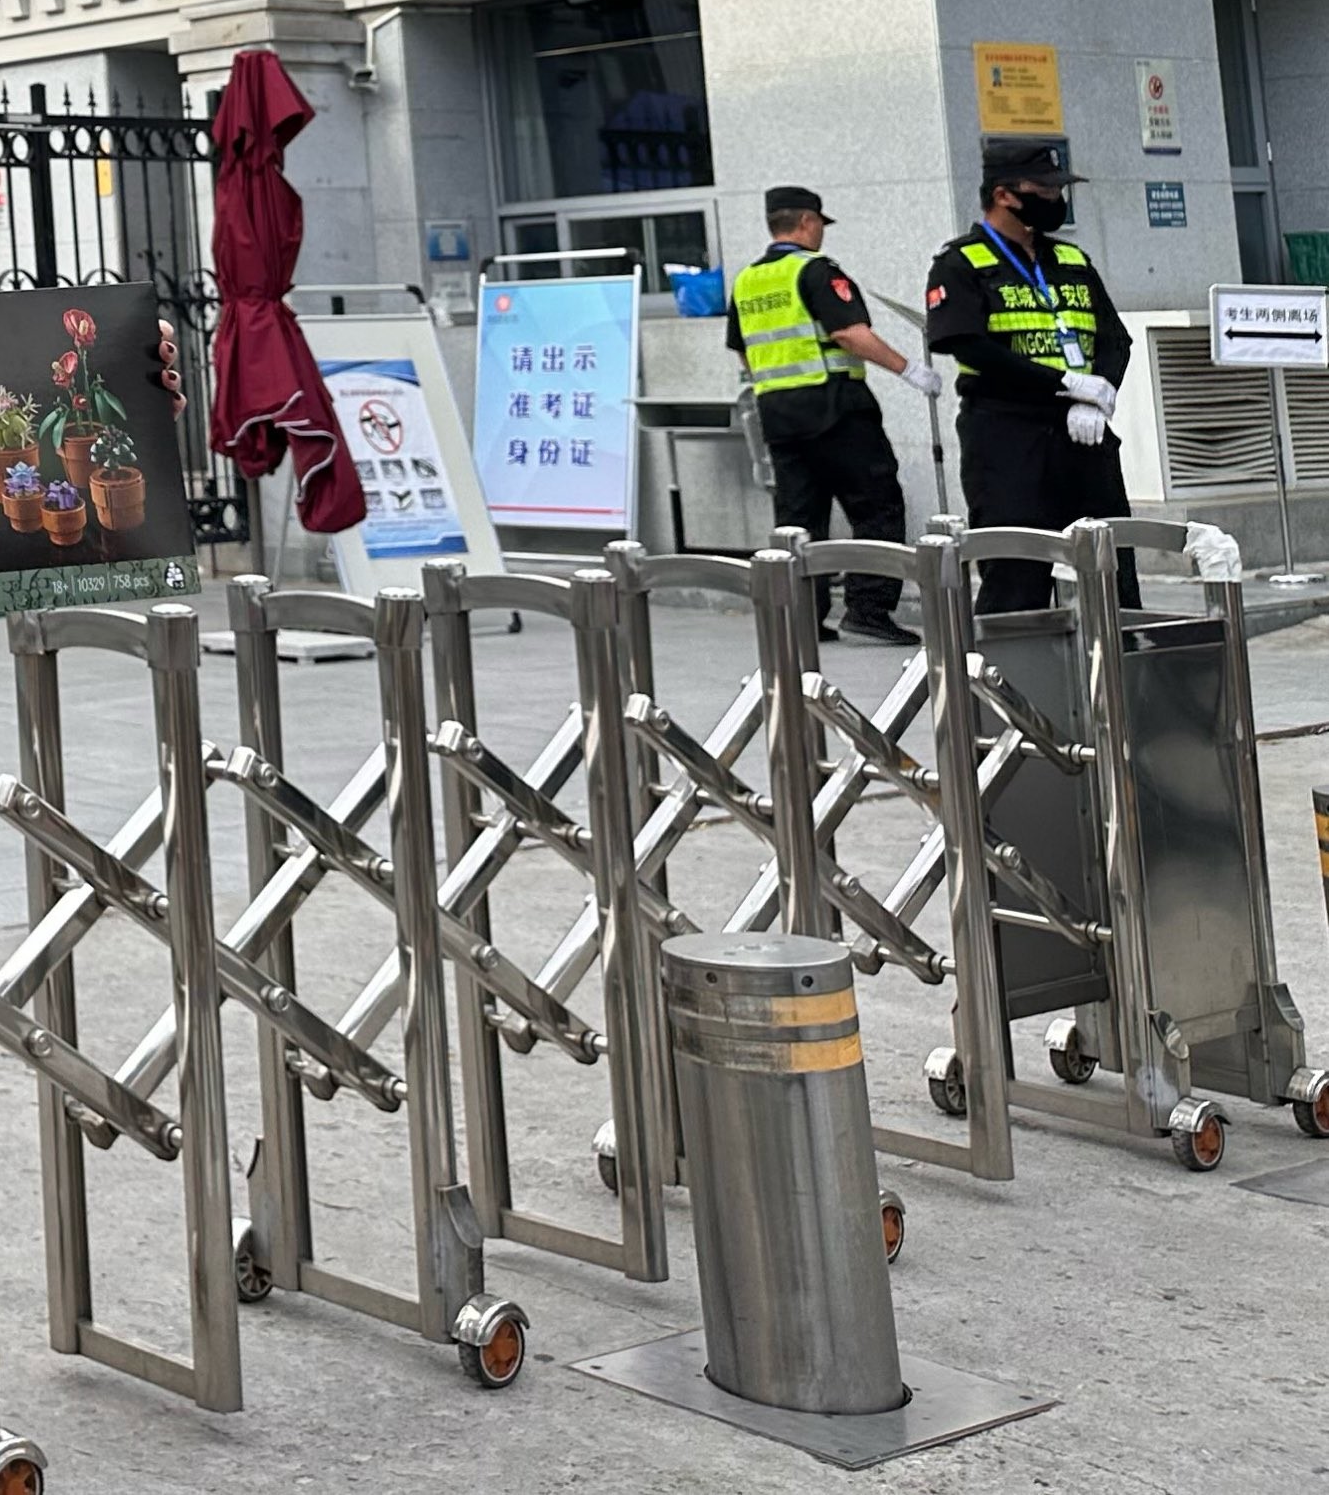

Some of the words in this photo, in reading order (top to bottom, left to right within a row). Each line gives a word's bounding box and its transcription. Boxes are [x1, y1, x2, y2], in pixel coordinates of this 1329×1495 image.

[1224, 306, 1319, 324] 考生两侧离场
[511, 345, 597, 373] 请出示
[508, 392, 595, 419] 准考证
[507, 439, 595, 466] 身份证
[52, 580, 69, 594] 18+
[77, 576, 105, 592] 10329
[113, 574, 131, 588] 758
[132, 576, 150, 590] pcs
